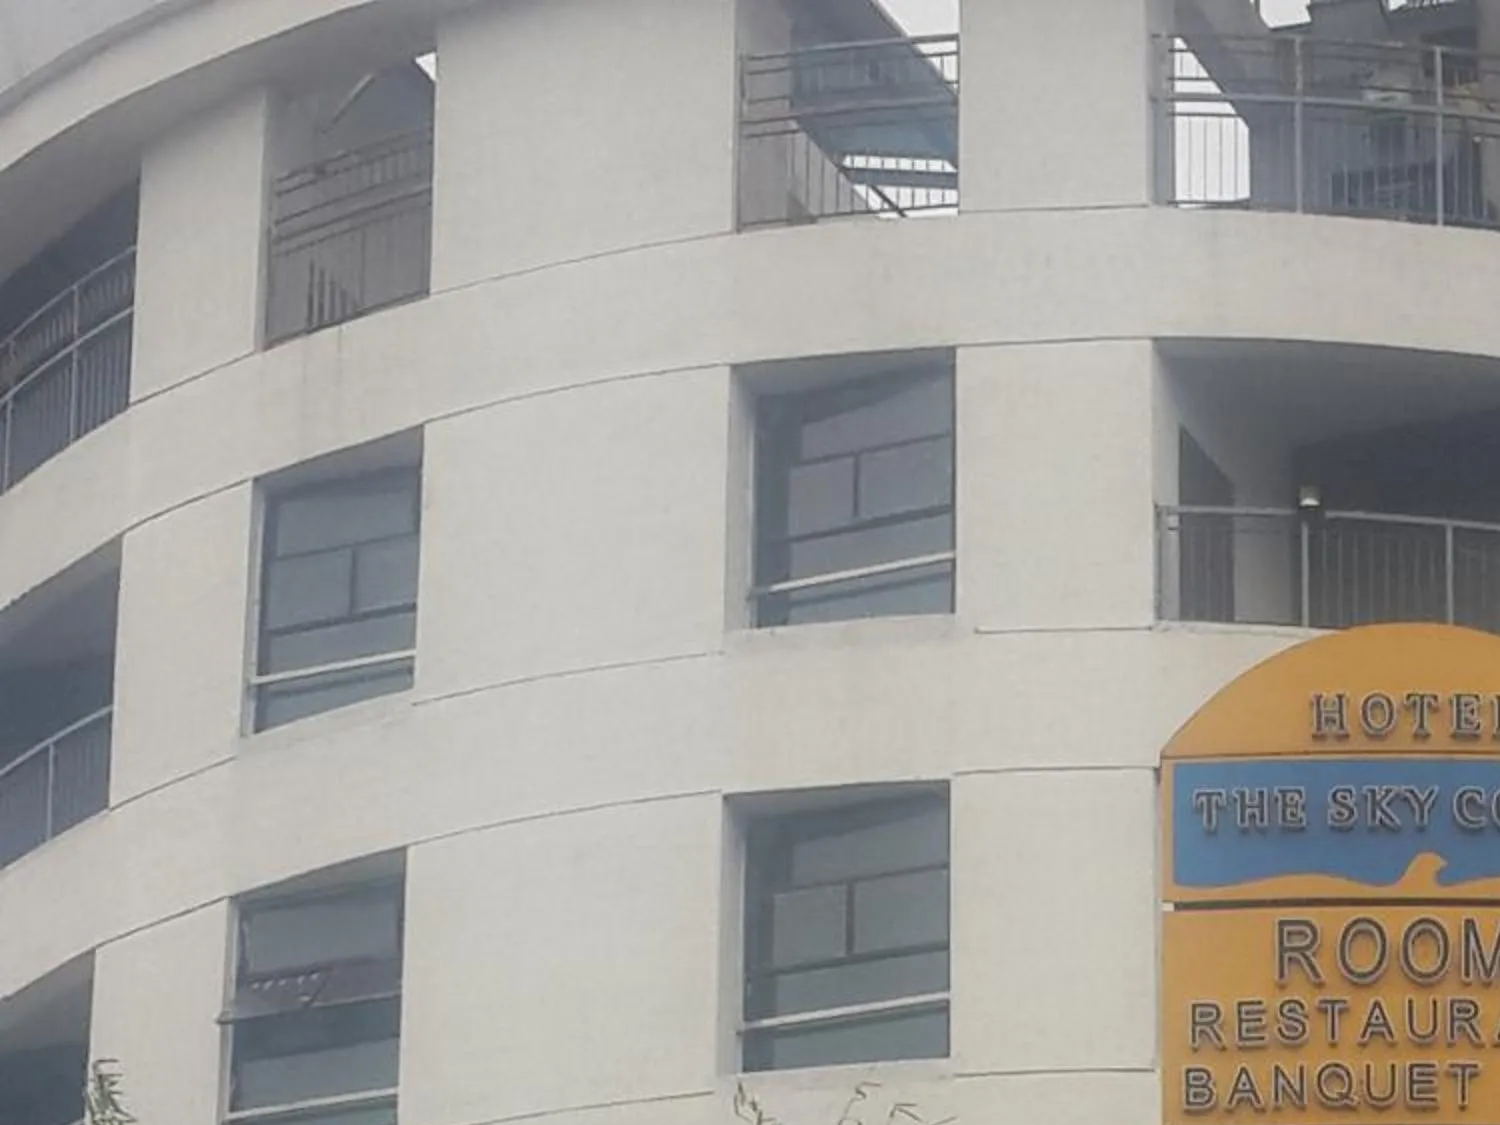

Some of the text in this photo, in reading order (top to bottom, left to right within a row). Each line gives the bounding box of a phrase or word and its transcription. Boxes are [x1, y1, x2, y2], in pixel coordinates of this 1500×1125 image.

[1194, 786, 1306, 832] THE
[1326, 786, 1440, 830] SKY
[1182, 1063, 1480, 1112] BANQUET
